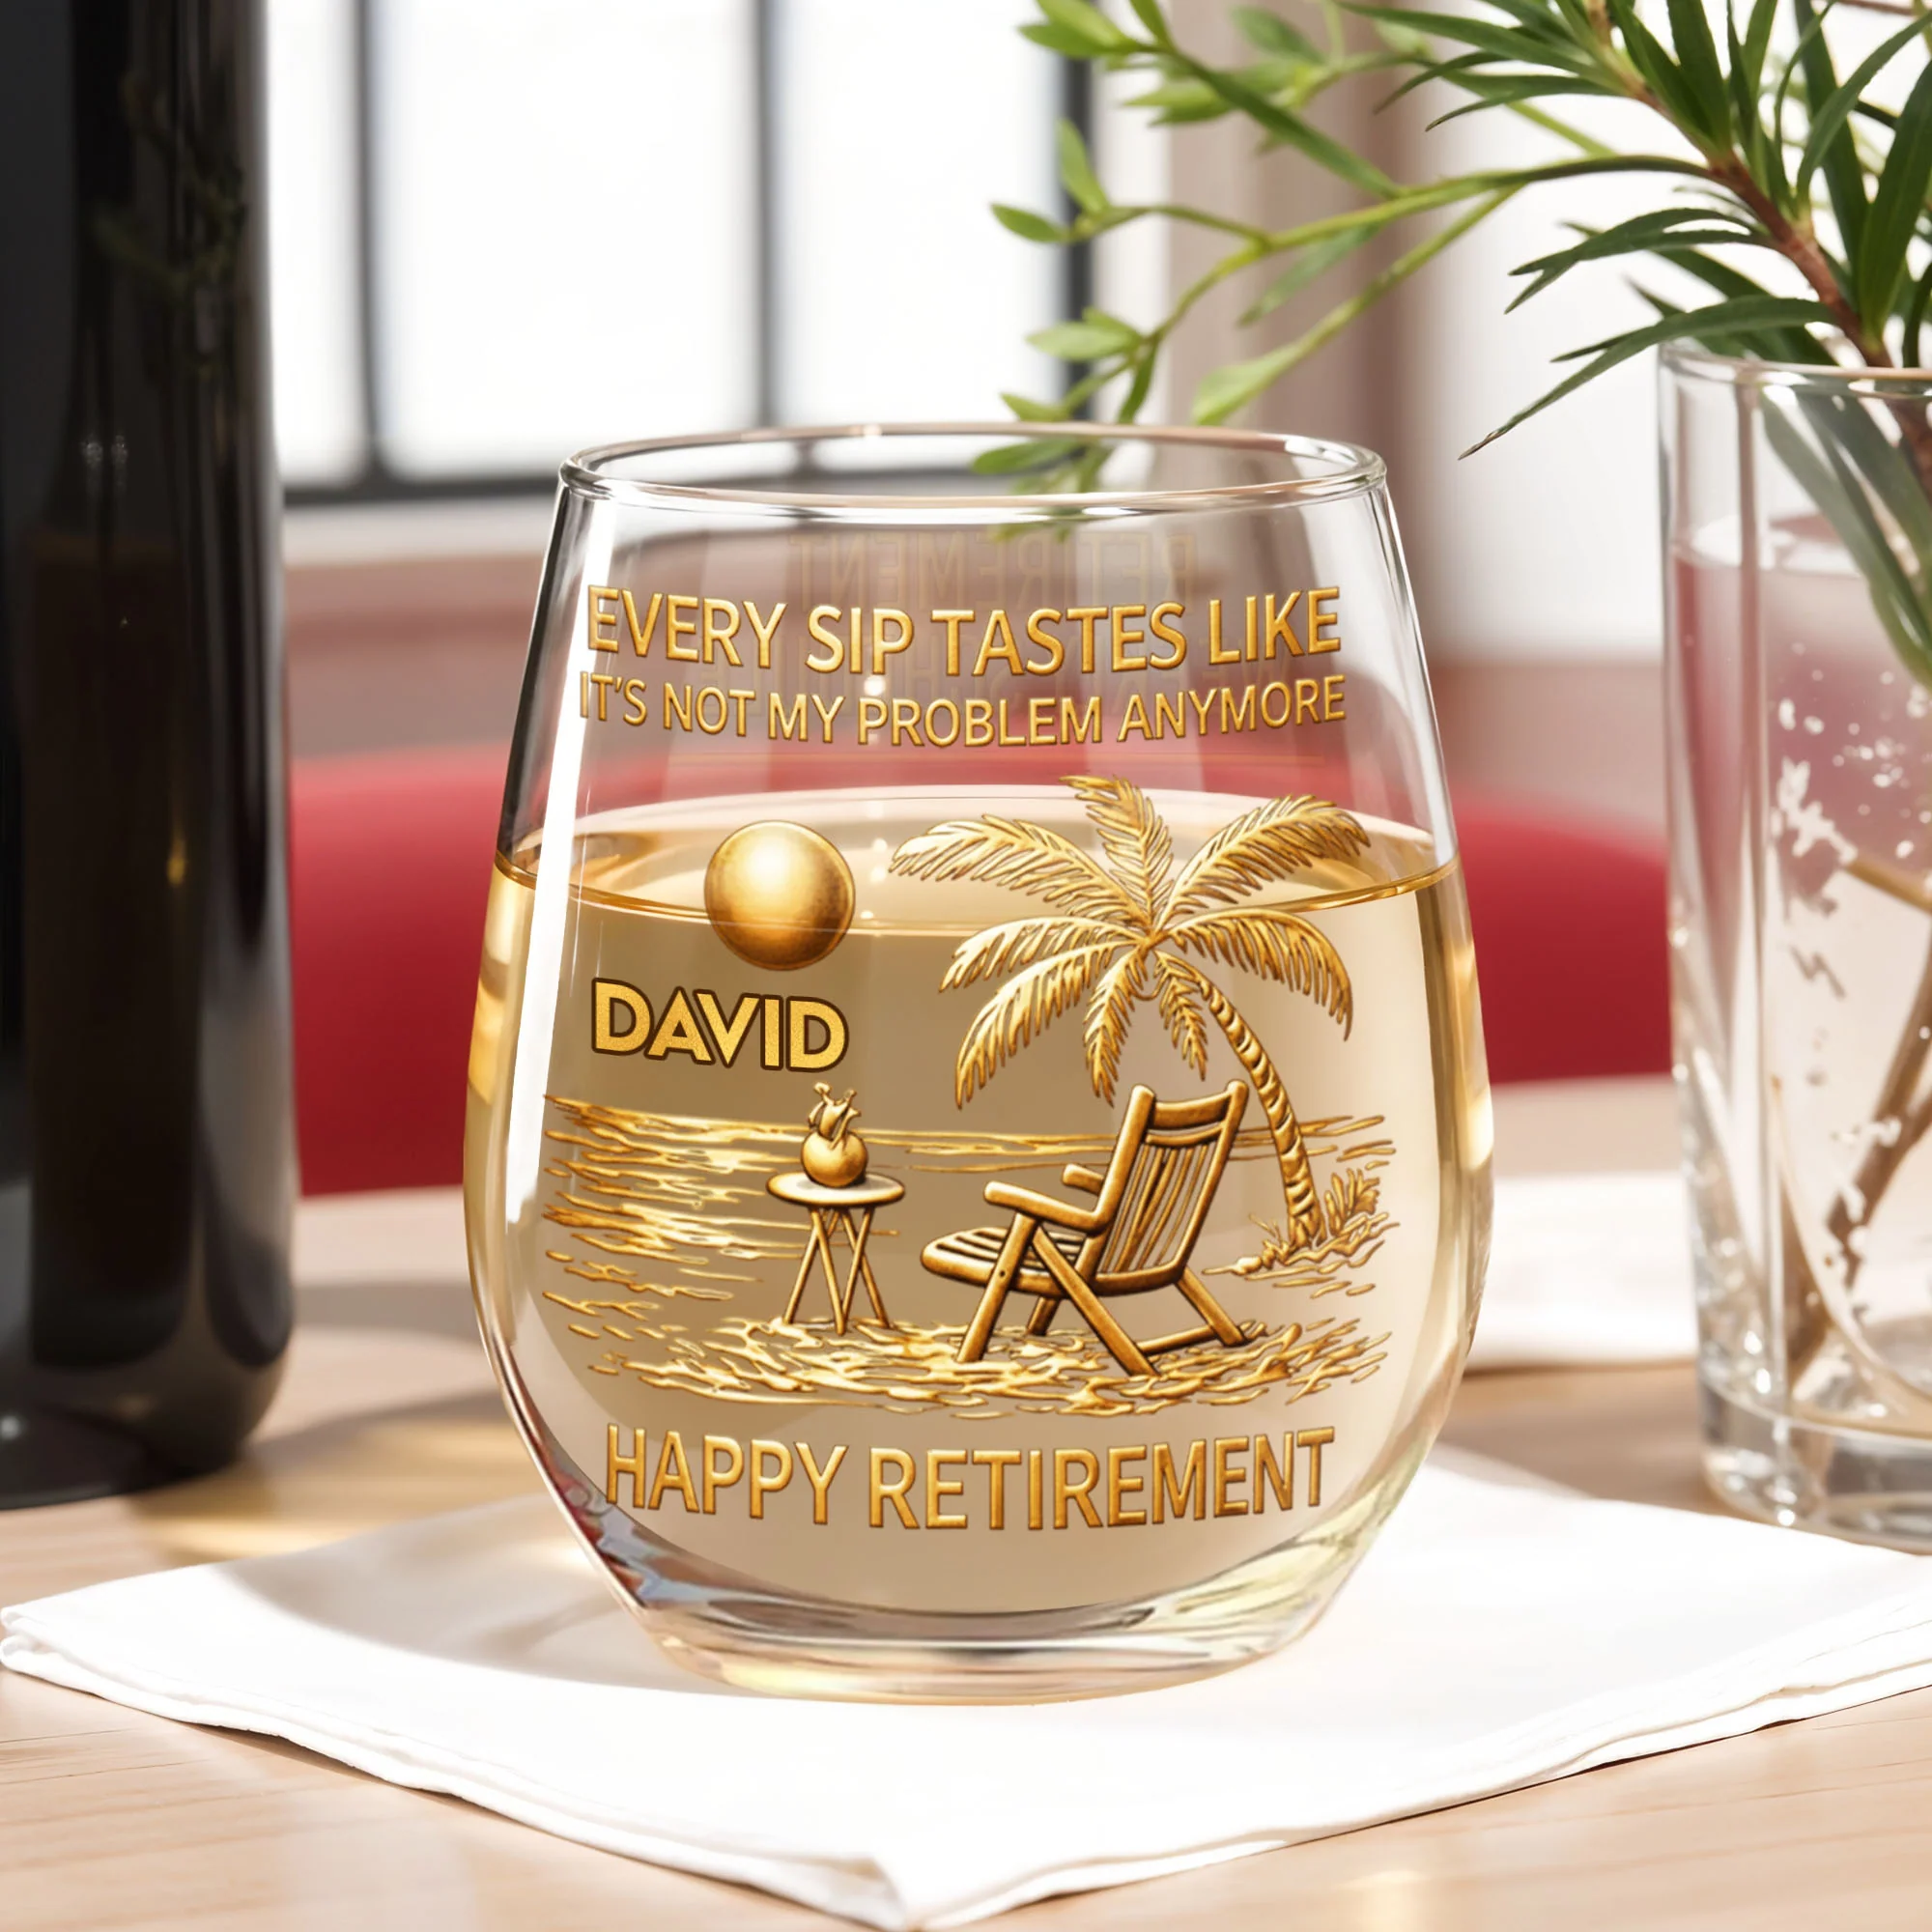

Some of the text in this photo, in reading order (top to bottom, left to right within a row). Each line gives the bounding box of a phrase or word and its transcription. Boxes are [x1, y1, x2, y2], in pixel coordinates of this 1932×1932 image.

[587, 584, 1341, 676] EVERY SIP TASTES LIKE
[580, 671, 648, 725] IT'S
[663, 682, 756, 737] NOT
[768, 692, 846, 744] MY
[857, 696, 1102, 749] PROBLEM
[1117, 675, 1346, 742] ANYMORE
[591, 977, 849, 1073] DAVID
[606, 1422, 1336, 1530] HAPPY RETIREMENT
